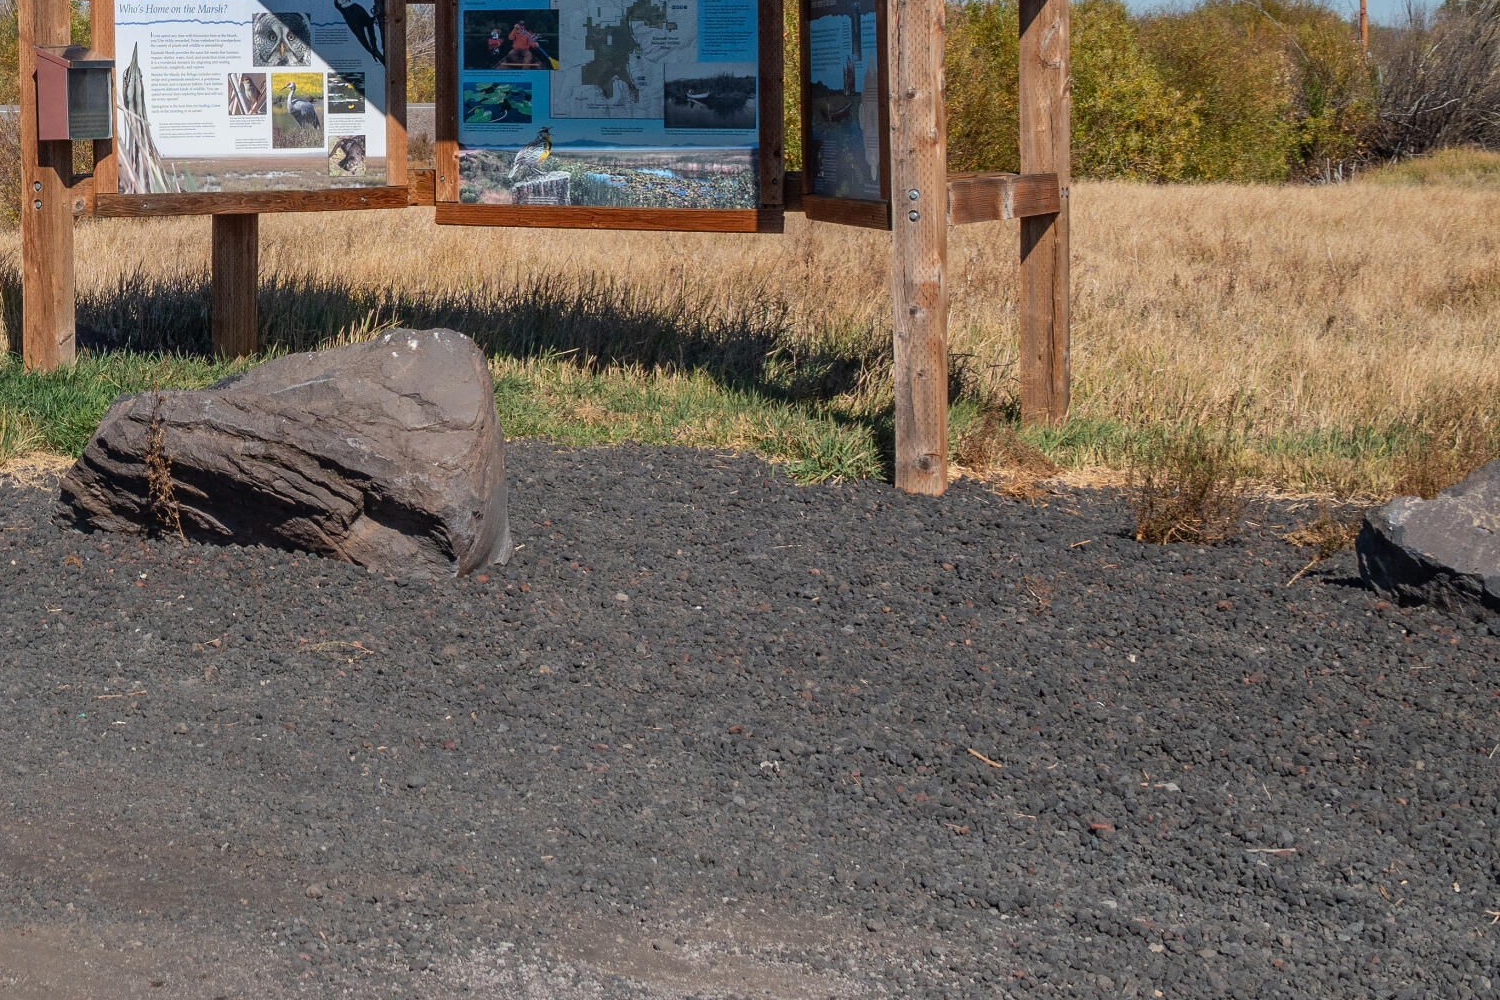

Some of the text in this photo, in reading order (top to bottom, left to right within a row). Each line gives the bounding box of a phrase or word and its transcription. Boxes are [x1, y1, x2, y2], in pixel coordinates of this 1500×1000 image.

[119, 3, 228, 14] Who's Home on the Marsh?
